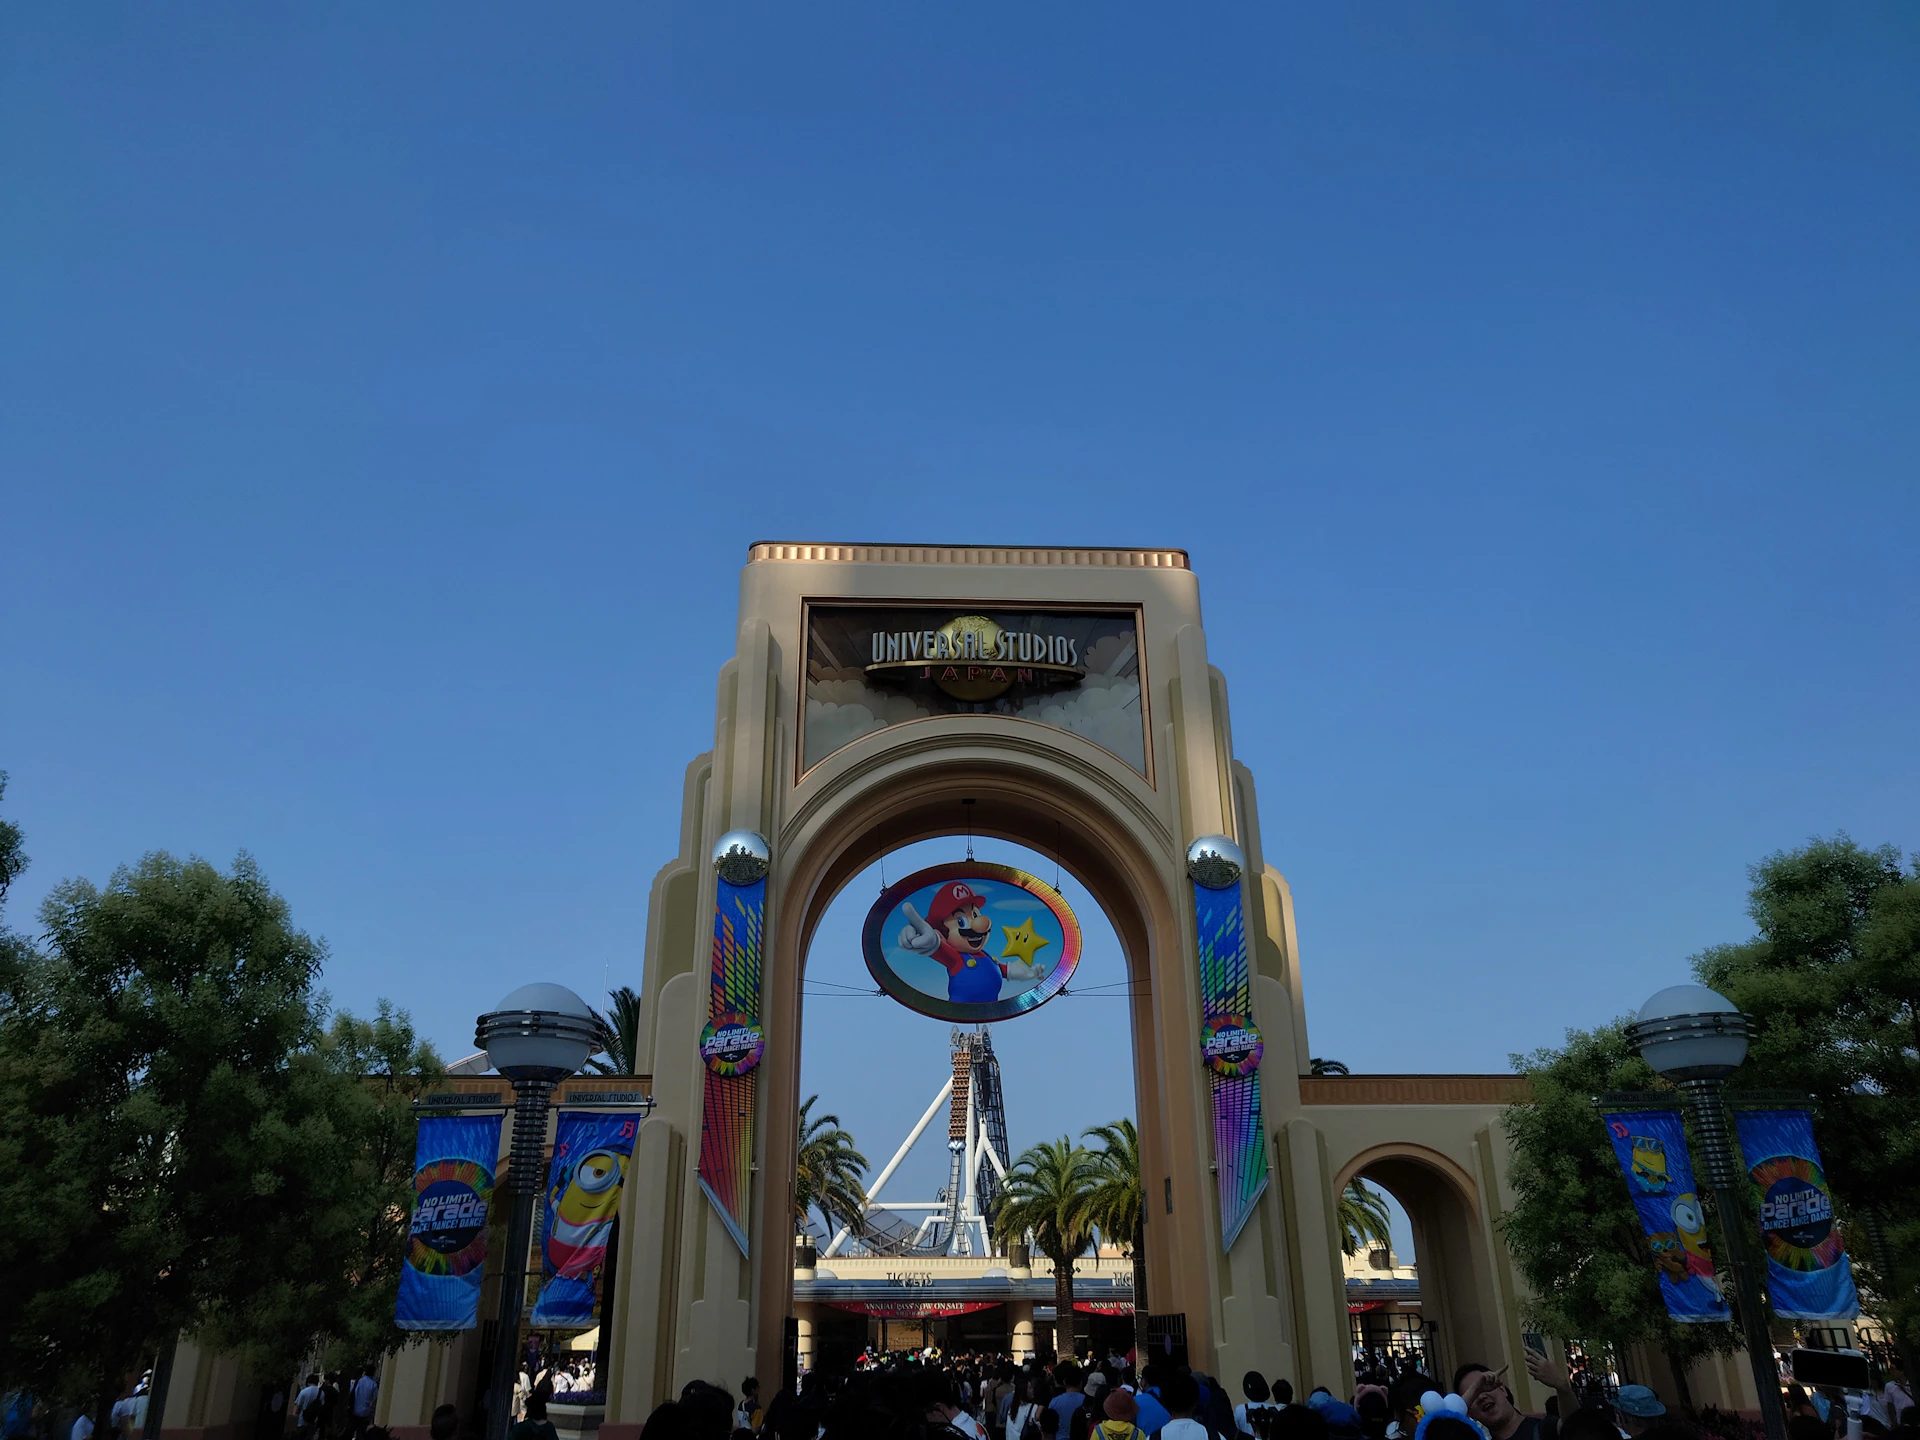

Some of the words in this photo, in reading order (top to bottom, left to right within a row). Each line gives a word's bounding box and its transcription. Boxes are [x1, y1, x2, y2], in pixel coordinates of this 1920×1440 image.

[872, 630, 989, 663] UNIVERSAL
[994, 629, 1078, 667] STUDIOS
[919, 665, 1033, 683] JAPAN
[716, 1030, 727, 1038] NO
[727, 1028, 748, 1036] LIMIT!
[1216, 1031, 1226, 1039] NO
[1226, 1029, 1246, 1037] LIMIT!
[428, 1095, 465, 1105] UNIVERSAL
[466, 1095, 497, 1105] STUDIOS
[569, 1093, 606, 1103] UNIVERSAL
[606, 1093, 638, 1102] STUDIOS
[422, 1197, 438, 1208] NO
[438, 1192, 474, 1206] LIMIT!
[1775, 1193, 1789, 1204] NO
[431, 1219, 459, 1231] DANCE!
[1763, 1219, 1790, 1231] DANCE!
[886, 1272, 934, 1287] TICKETS
[865, 1302, 894, 1310] ANNUAL
[896, 1302, 913, 1310] PASS
[913, 1302, 933, 1310] NOW
[934, 1302, 946, 1310] ON
[946, 1302, 965, 1310] SALE
